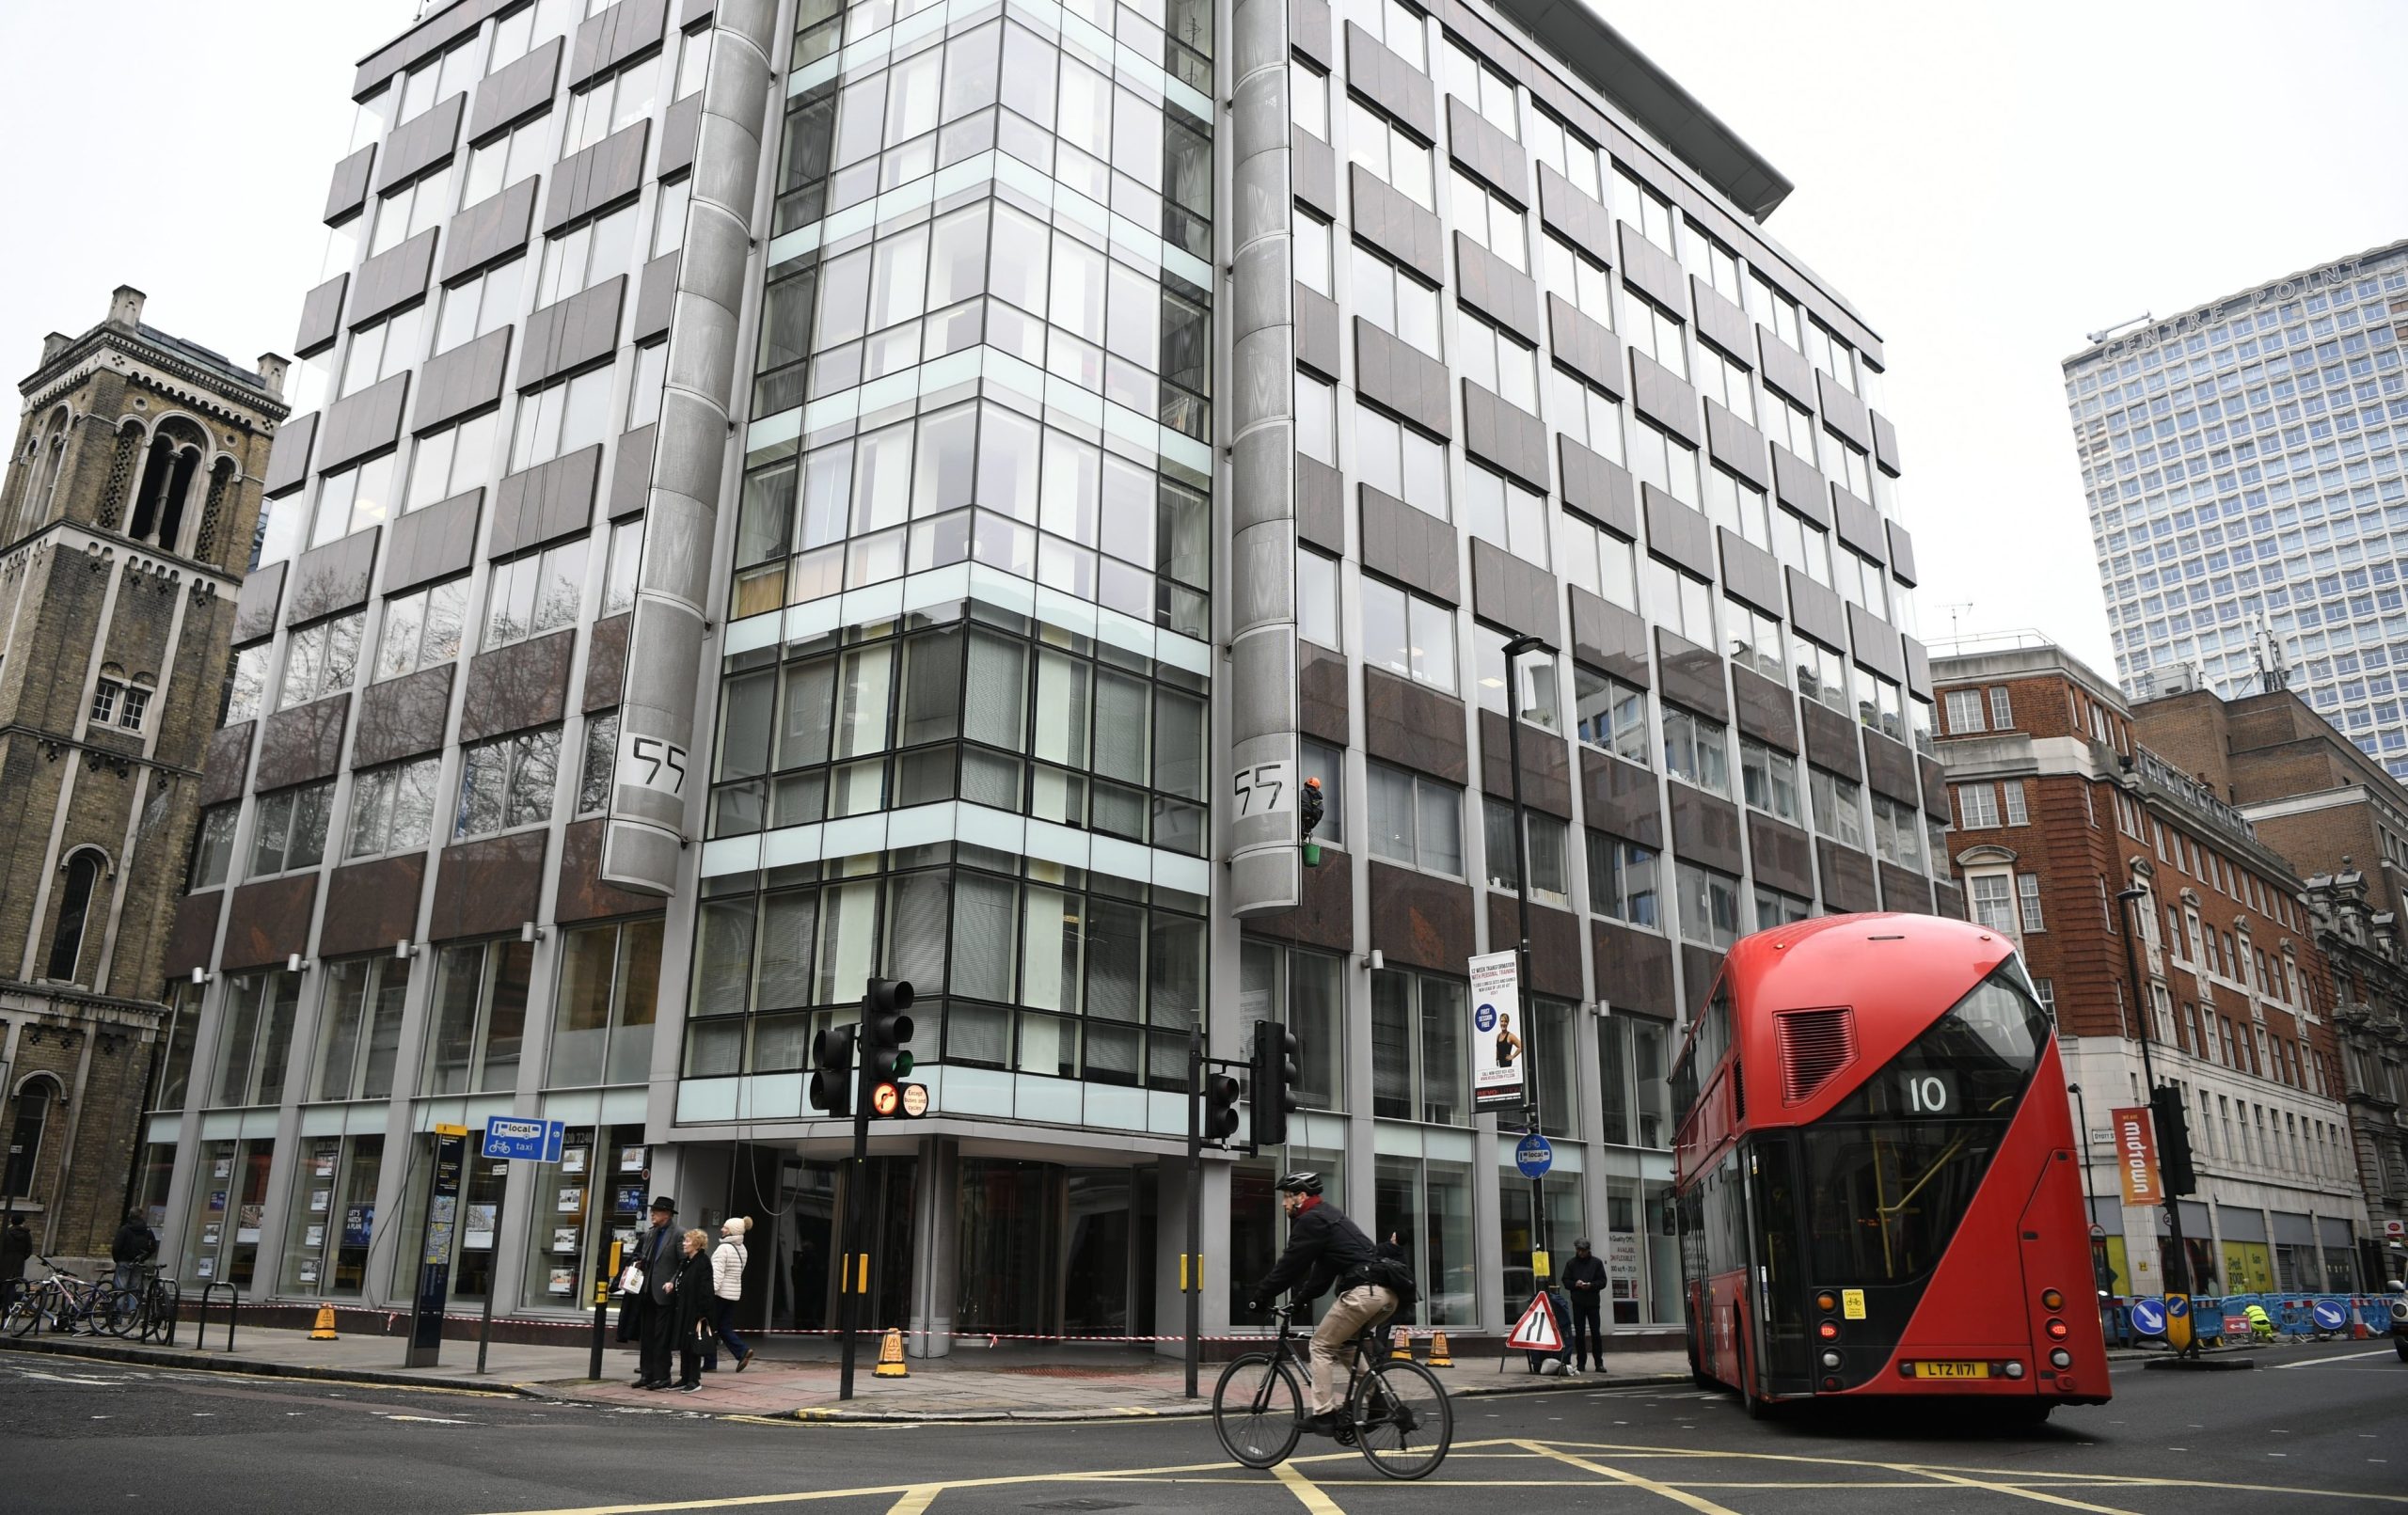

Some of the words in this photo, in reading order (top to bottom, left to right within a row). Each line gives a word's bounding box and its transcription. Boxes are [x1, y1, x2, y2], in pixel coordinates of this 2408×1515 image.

[2103, 304, 2226, 362] CENTRE
[2251, 259, 2363, 308] POINT
[633, 737, 687, 794] 55
[1234, 764, 1283, 815] 55
[1910, 1077, 1946, 1112] 10
[509, 1124, 531, 1133] local
[516, 1142, 533, 1151] taxi
[1927, 1363, 1954, 1376] LTZ
[1956, 1363, 1976, 1376] 1171
